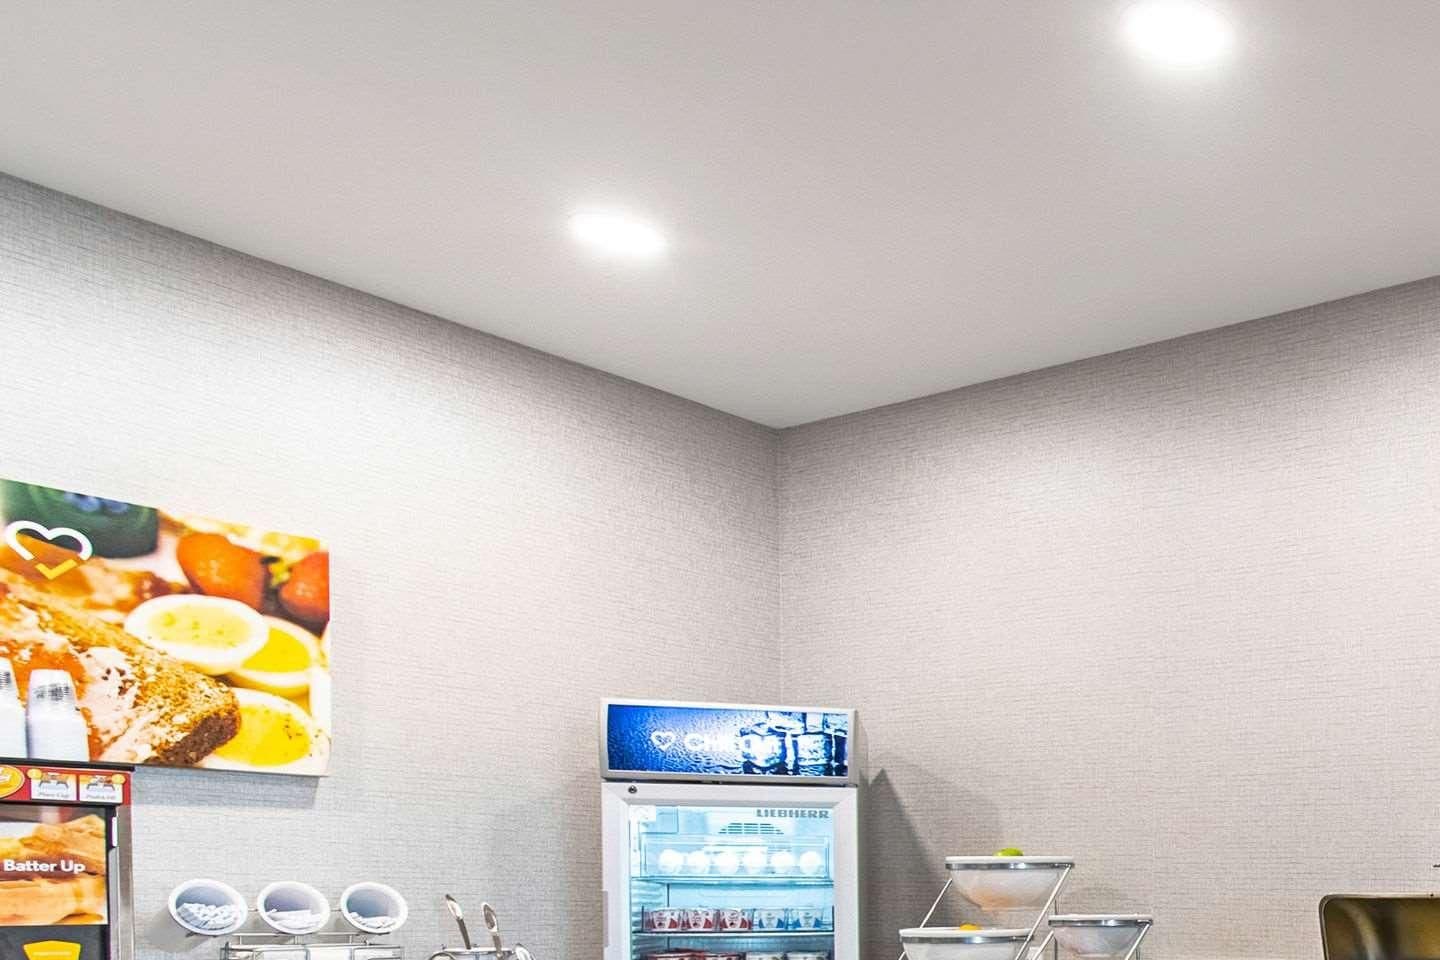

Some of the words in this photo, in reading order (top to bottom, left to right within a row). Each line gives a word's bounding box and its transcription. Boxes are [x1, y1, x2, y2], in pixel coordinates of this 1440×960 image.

[756, 809, 830, 819] LIEBHERR
[3, 859, 57, 872] Batter
[60, 859, 86, 874] Up
